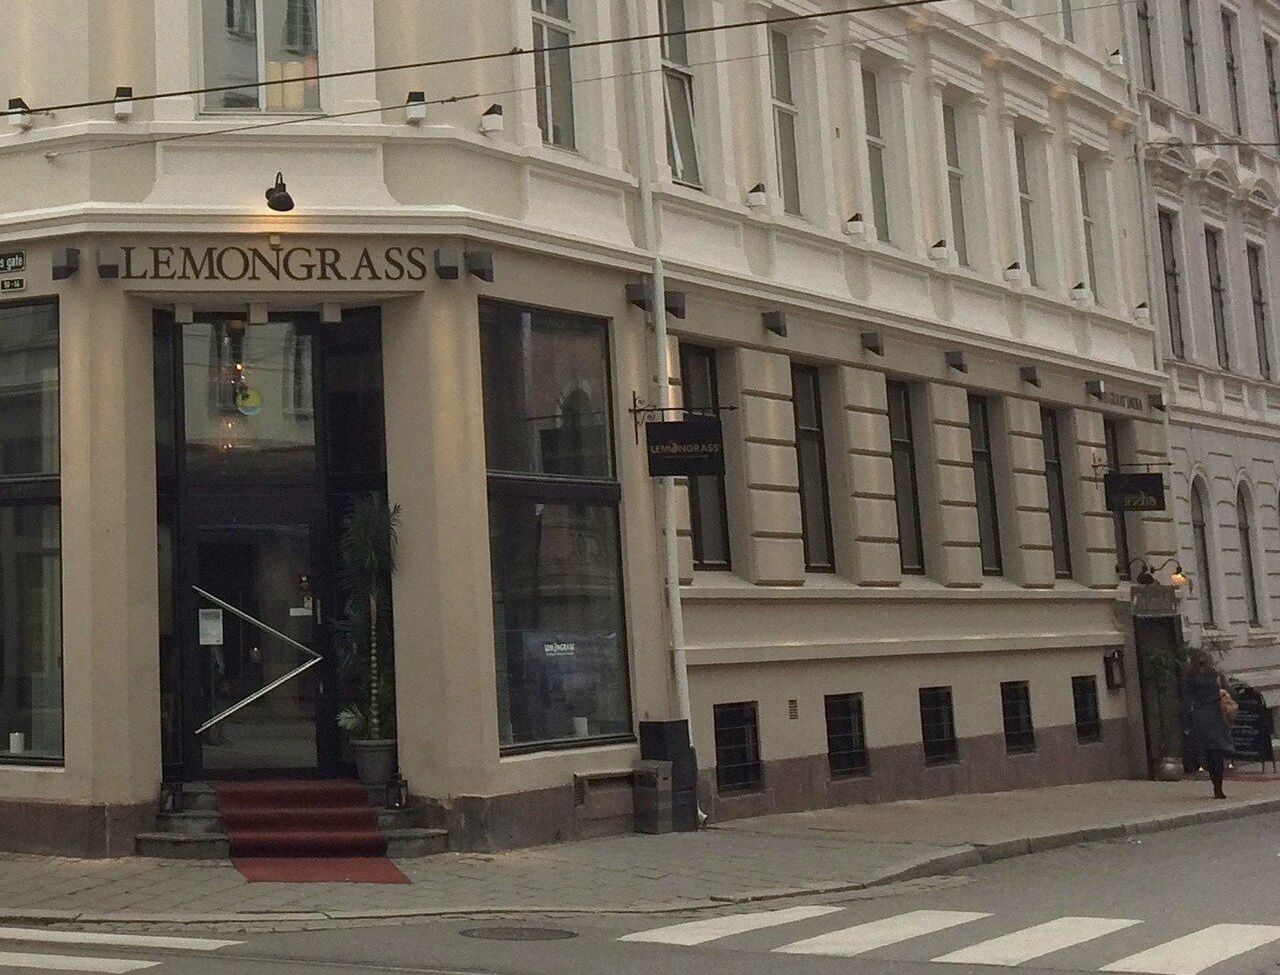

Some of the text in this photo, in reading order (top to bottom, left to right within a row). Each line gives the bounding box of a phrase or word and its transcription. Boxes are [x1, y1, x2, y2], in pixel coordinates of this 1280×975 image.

[6, 254, 23, 271] gate
[120, 246, 427, 281] LEMONGRASS
[650, 443, 719, 455] LEMONGRASS
